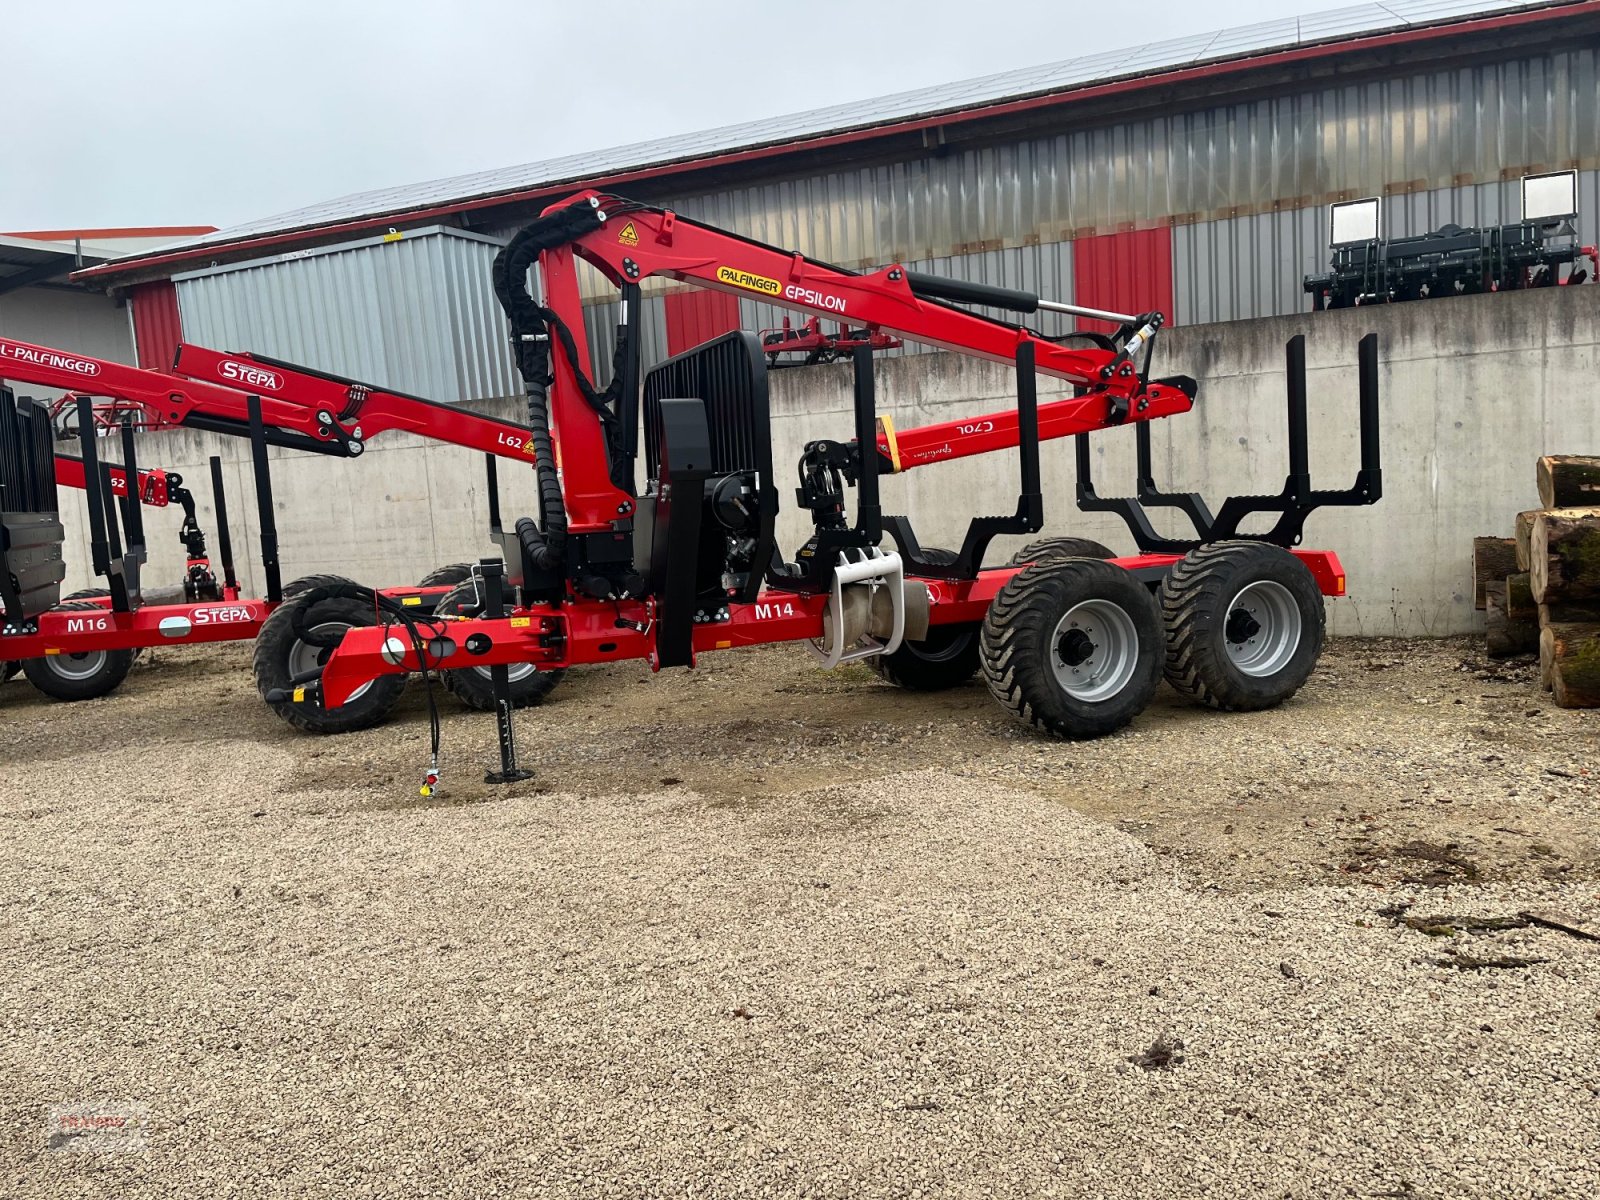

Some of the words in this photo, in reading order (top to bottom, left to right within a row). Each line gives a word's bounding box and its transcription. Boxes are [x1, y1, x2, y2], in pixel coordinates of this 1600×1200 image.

[720, 269, 778, 292] PALFINGER
[785, 284, 847, 312] EPSILON
[0, 344, 96, 375] L-PALFINGER
[223, 361, 276, 389] STEPA
[956, 421, 993, 435] C70L
[497, 432, 522, 449] L62
[194, 608, 251, 624] STEPA
